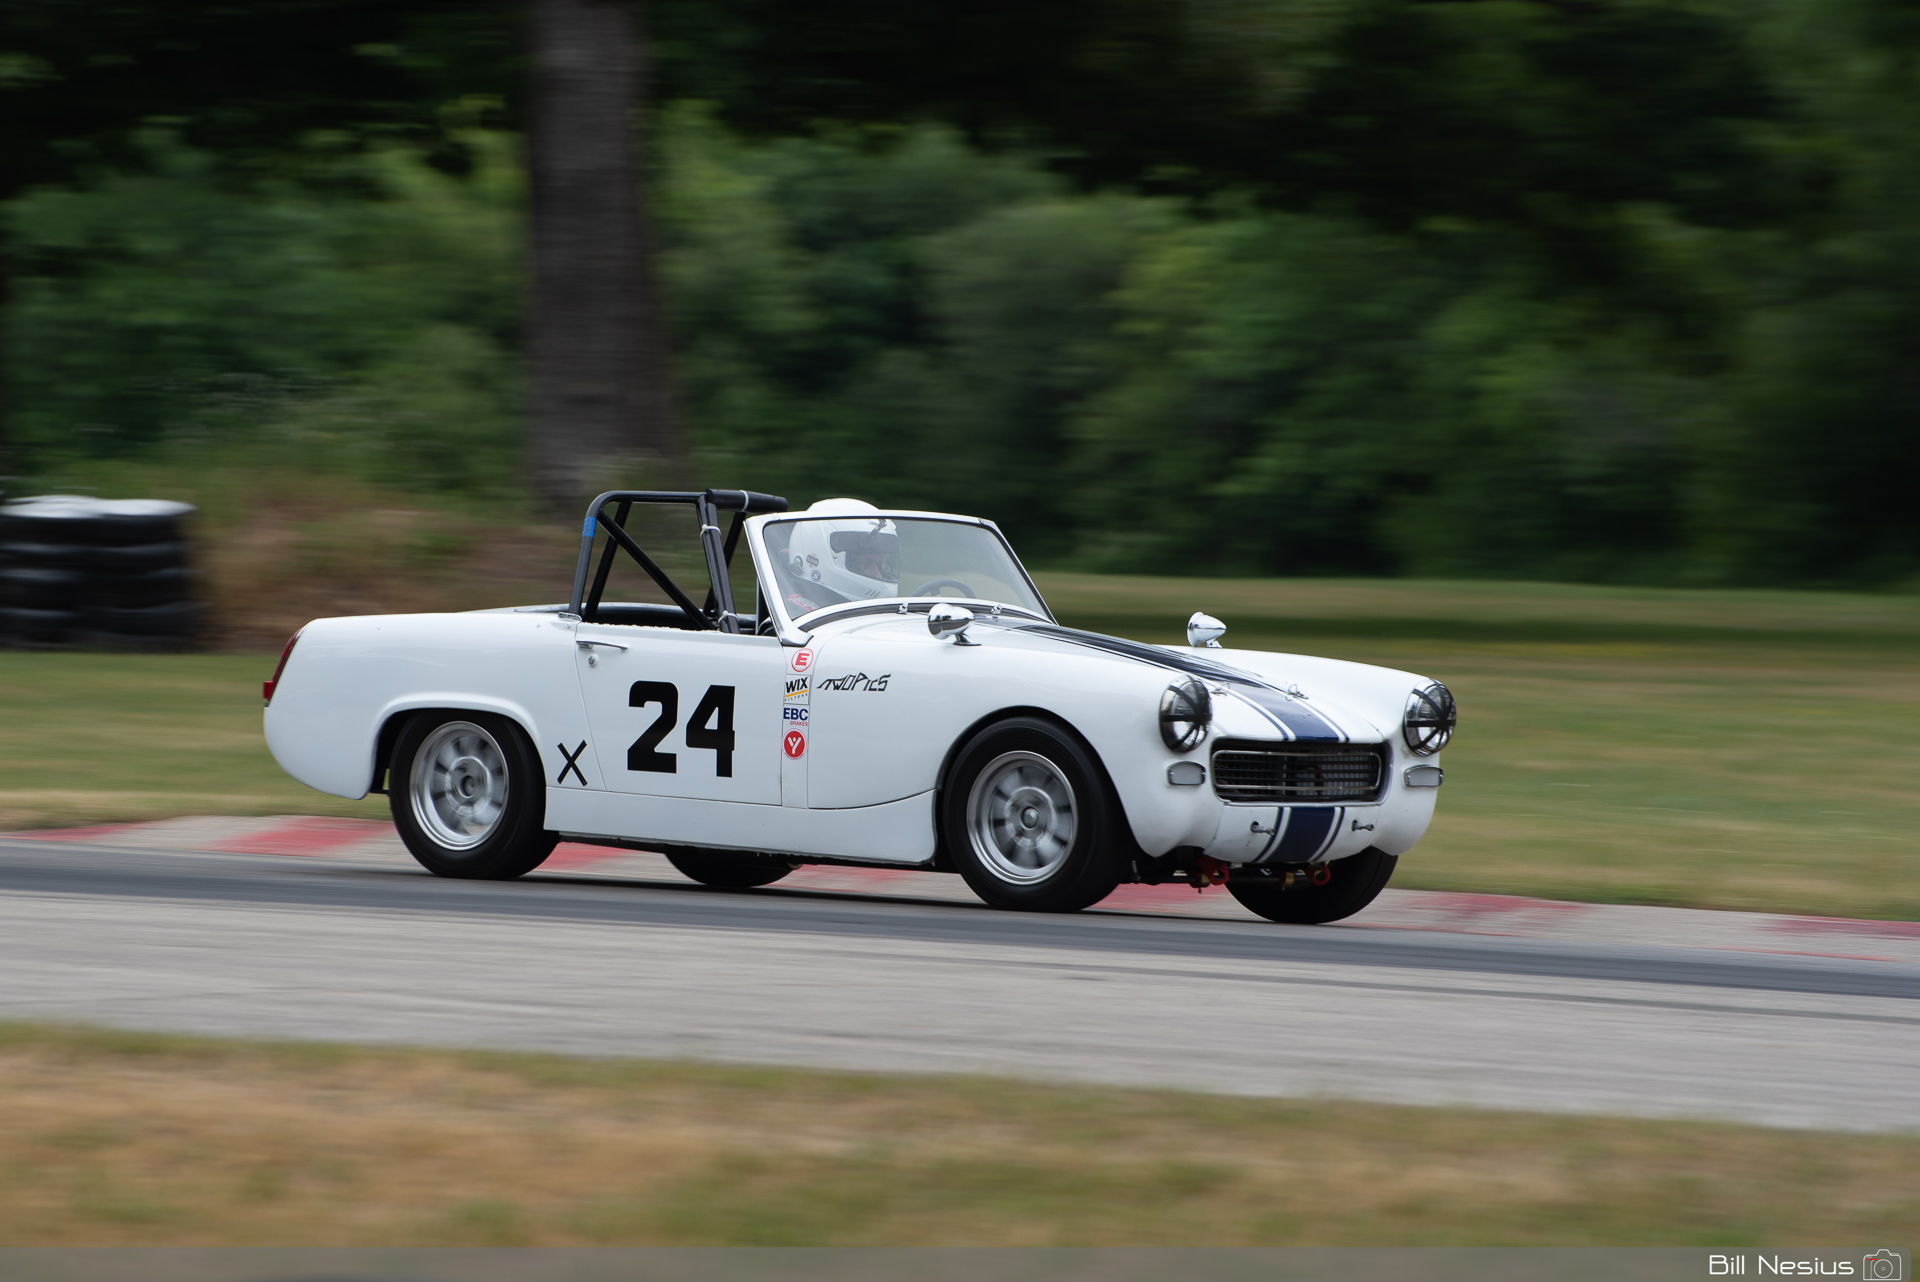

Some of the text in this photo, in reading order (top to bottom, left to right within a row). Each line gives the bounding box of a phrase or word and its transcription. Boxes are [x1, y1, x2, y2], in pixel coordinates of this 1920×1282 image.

[785, 677, 808, 693] WIX
[784, 693, 808, 702] FILTERS
[783, 707, 808, 721] EBC
[627, 680, 736, 778] 24
[557, 739, 588, 787] X
